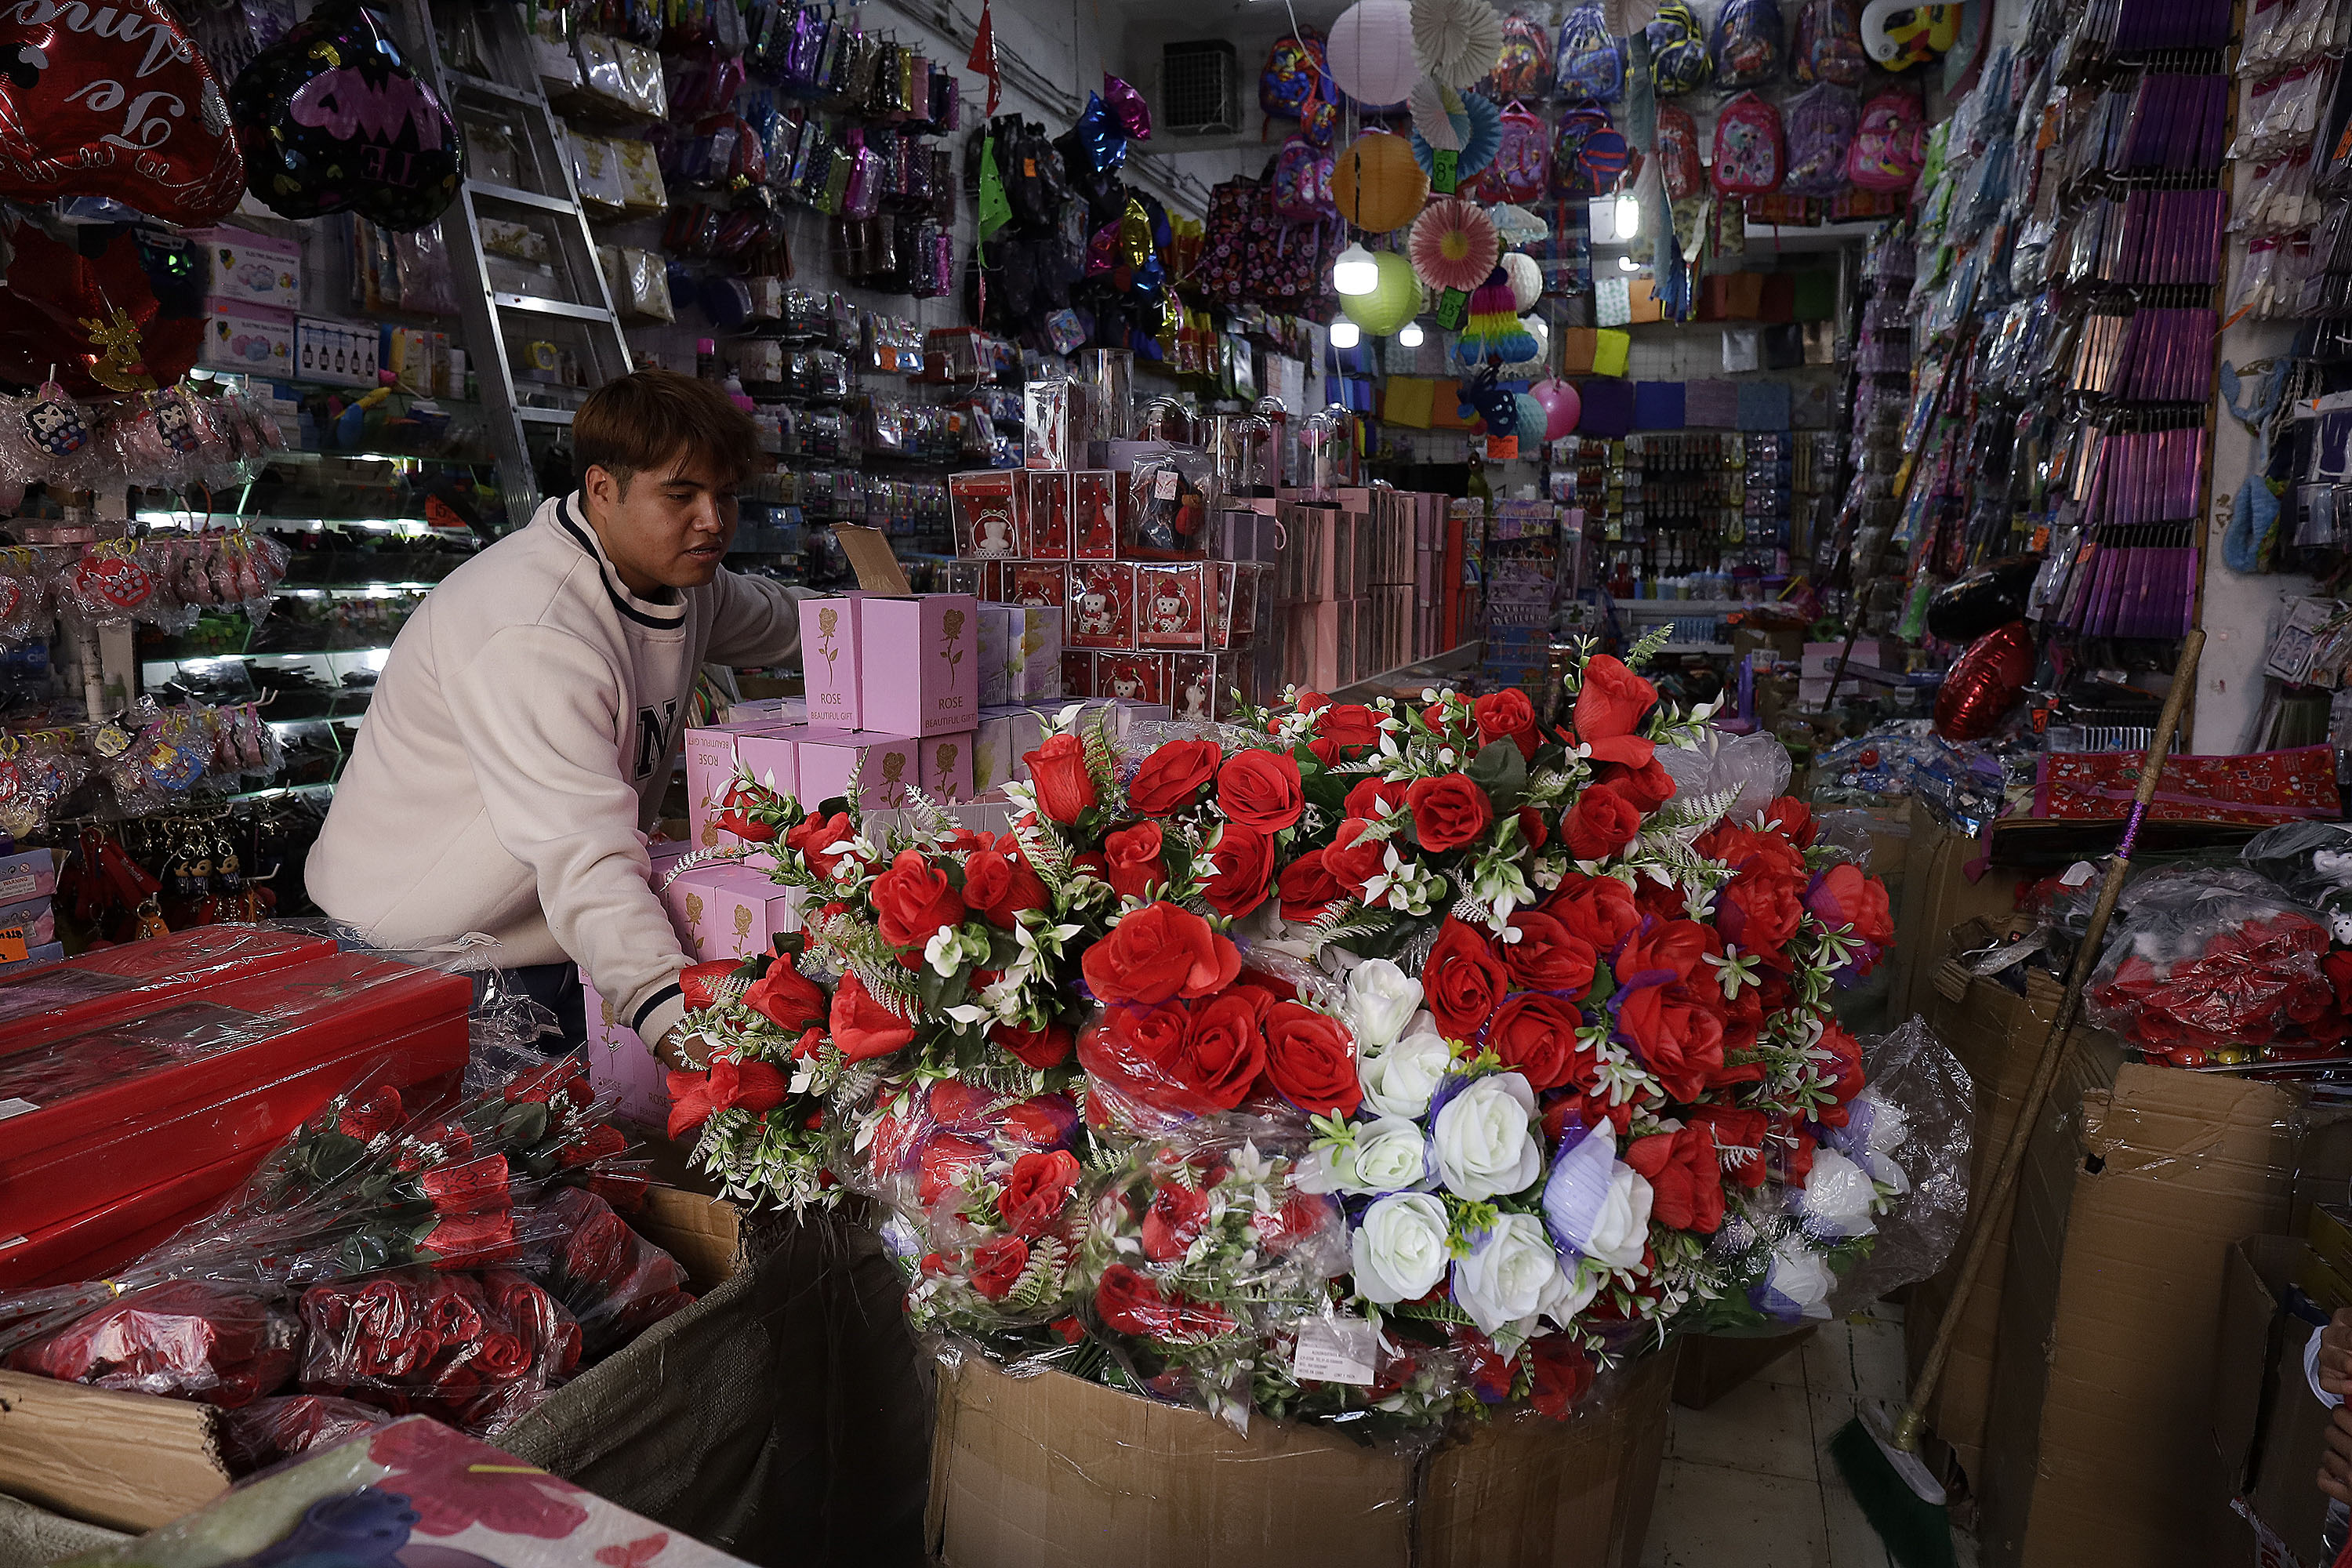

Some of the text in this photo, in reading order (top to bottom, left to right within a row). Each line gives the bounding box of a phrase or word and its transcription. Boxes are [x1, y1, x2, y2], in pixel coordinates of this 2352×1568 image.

[0, 0, 198, 78] Amo
[63, 78, 186, 151] Te
[821, 693, 841, 705] ROSE
[938, 695, 964, 710] ROSE
[811, 711, 853, 720] BEAUTIFUL GIFT
[925, 713, 975, 728] BEAUTIFUL GIFT
[688, 737, 729, 750] BEAUTIFUL GIFT
[699, 753, 719, 767] ROSE
[648, 1091, 669, 1109] ROSE
